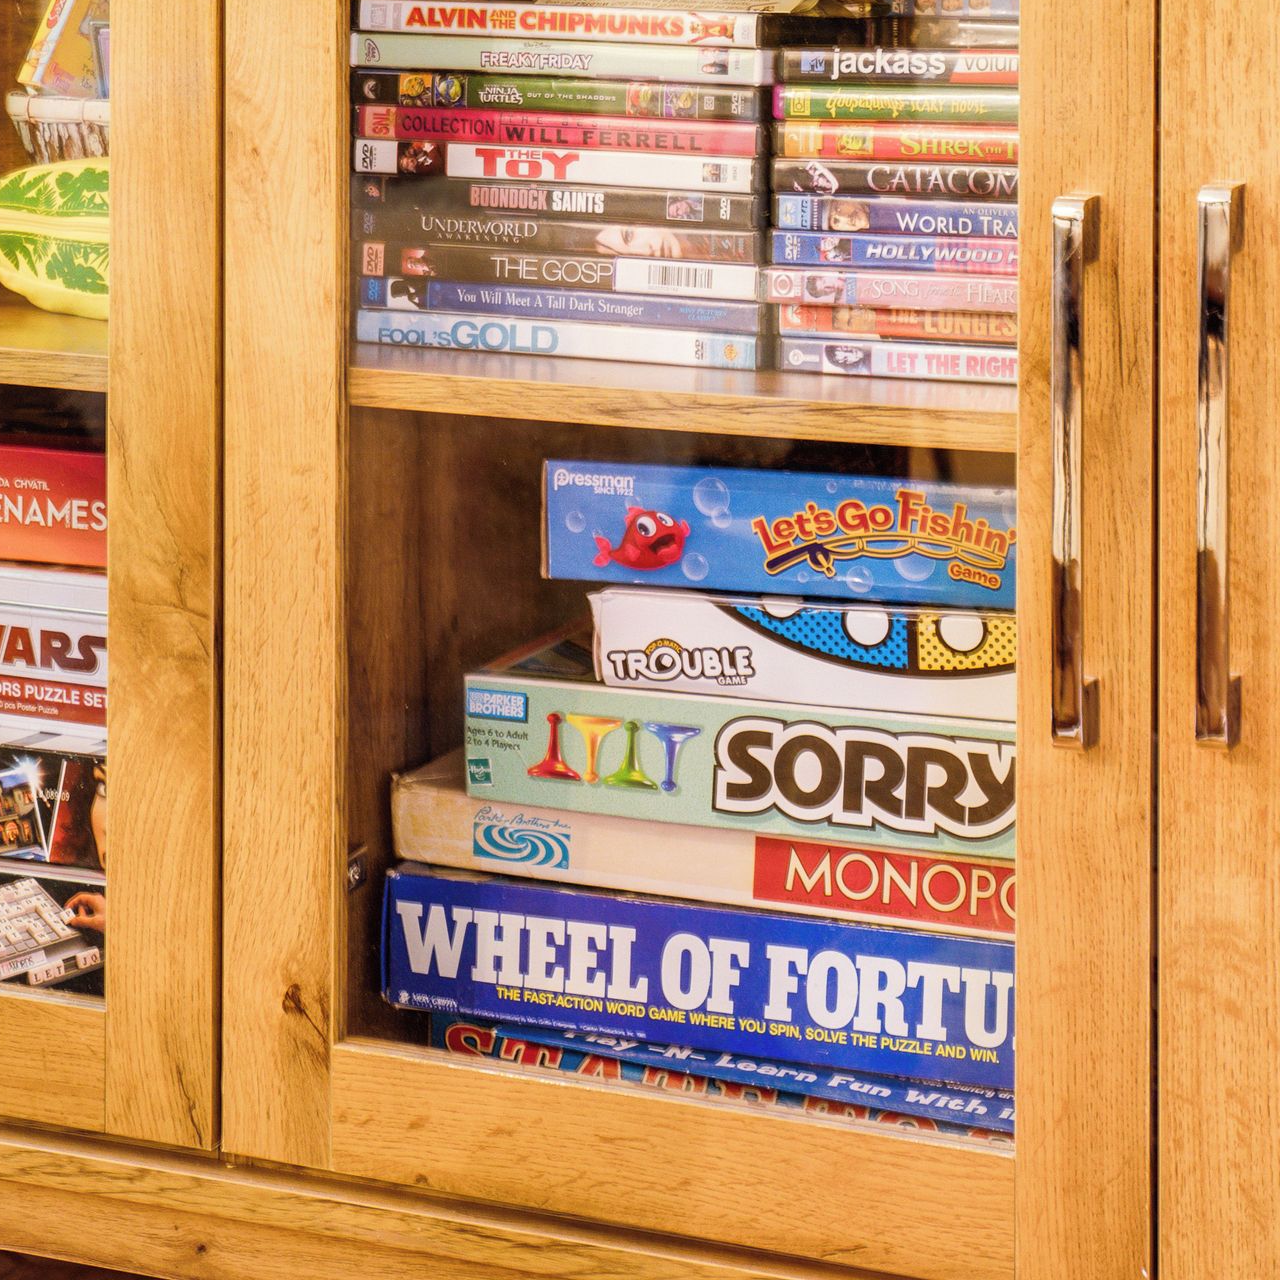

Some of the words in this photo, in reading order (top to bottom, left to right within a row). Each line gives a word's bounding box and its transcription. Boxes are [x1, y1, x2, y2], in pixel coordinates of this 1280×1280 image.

[405, 6, 488, 30] ALVIN
[489, 9, 517, 19] AND
[519, 10, 685, 37] CHIPMUNKS
[491, 18, 517, 30] THE
[831, 48, 947, 81] jackass
[485, 85, 519, 96] NINJA
[401, 112, 496, 137] COLLECTION
[505, 127, 569, 145] WILL
[582, 130, 704, 152] FERRELL
[475, 147, 580, 181] TOY
[505, 148, 541, 161] THE
[470, 187, 548, 212] BOONDOCK
[551, 190, 605, 215] SAINTS
[436, 231, 521, 244] AWAKENING
[865, 242, 1003, 264] HOLLYWOOD
[594, 485, 616, 495] SINCE
[615, 486, 635, 497] 1922
[751, 500, 837, 558] Let's
[837, 498, 895, 534] Go
[895, 487, 1017, 558] Fishin'
[948, 561, 1002, 589] Game
[607, 645, 755, 681] TROUBLE
[716, 675, 749, 686] GAME
[24, 681, 81, 706] PUZZLE
[483, 693, 525, 708] PARKER
[468, 702, 525, 719] BROTHERS
[466, 737, 472, 746] 2
[473, 738, 483, 747] to
[483, 739, 490, 749] 4
[491, 740, 521, 753] Players
[467, 725, 487, 738] Ages
[487, 727, 495, 737] 6
[495, 729, 505, 739] to
[505, 730, 529, 742] Adult
[396, 899, 649, 1004] WHEEL
[660, 931, 751, 1014] OF
[765, 942, 1015, 1052] FORTU
[496, 986, 522, 1002] THE
[523, 990, 604, 1013] FAST-ACTION
[606, 1001, 646, 1018] WORD
[648, 1007, 687, 1024] GAME
[690, 1012, 736, 1031] WHERE
[738, 1018, 768, 1035] YOU
[769, 1022, 803, 1041] SPIN,
[805, 1027, 848, 1045] SOLVE
[850, 1032, 878, 1049] THE
[880, 1037, 933, 1056] PUZZLE
[935, 1043, 967, 1060] AND
[969, 1048, 1001, 1064] WIN.
